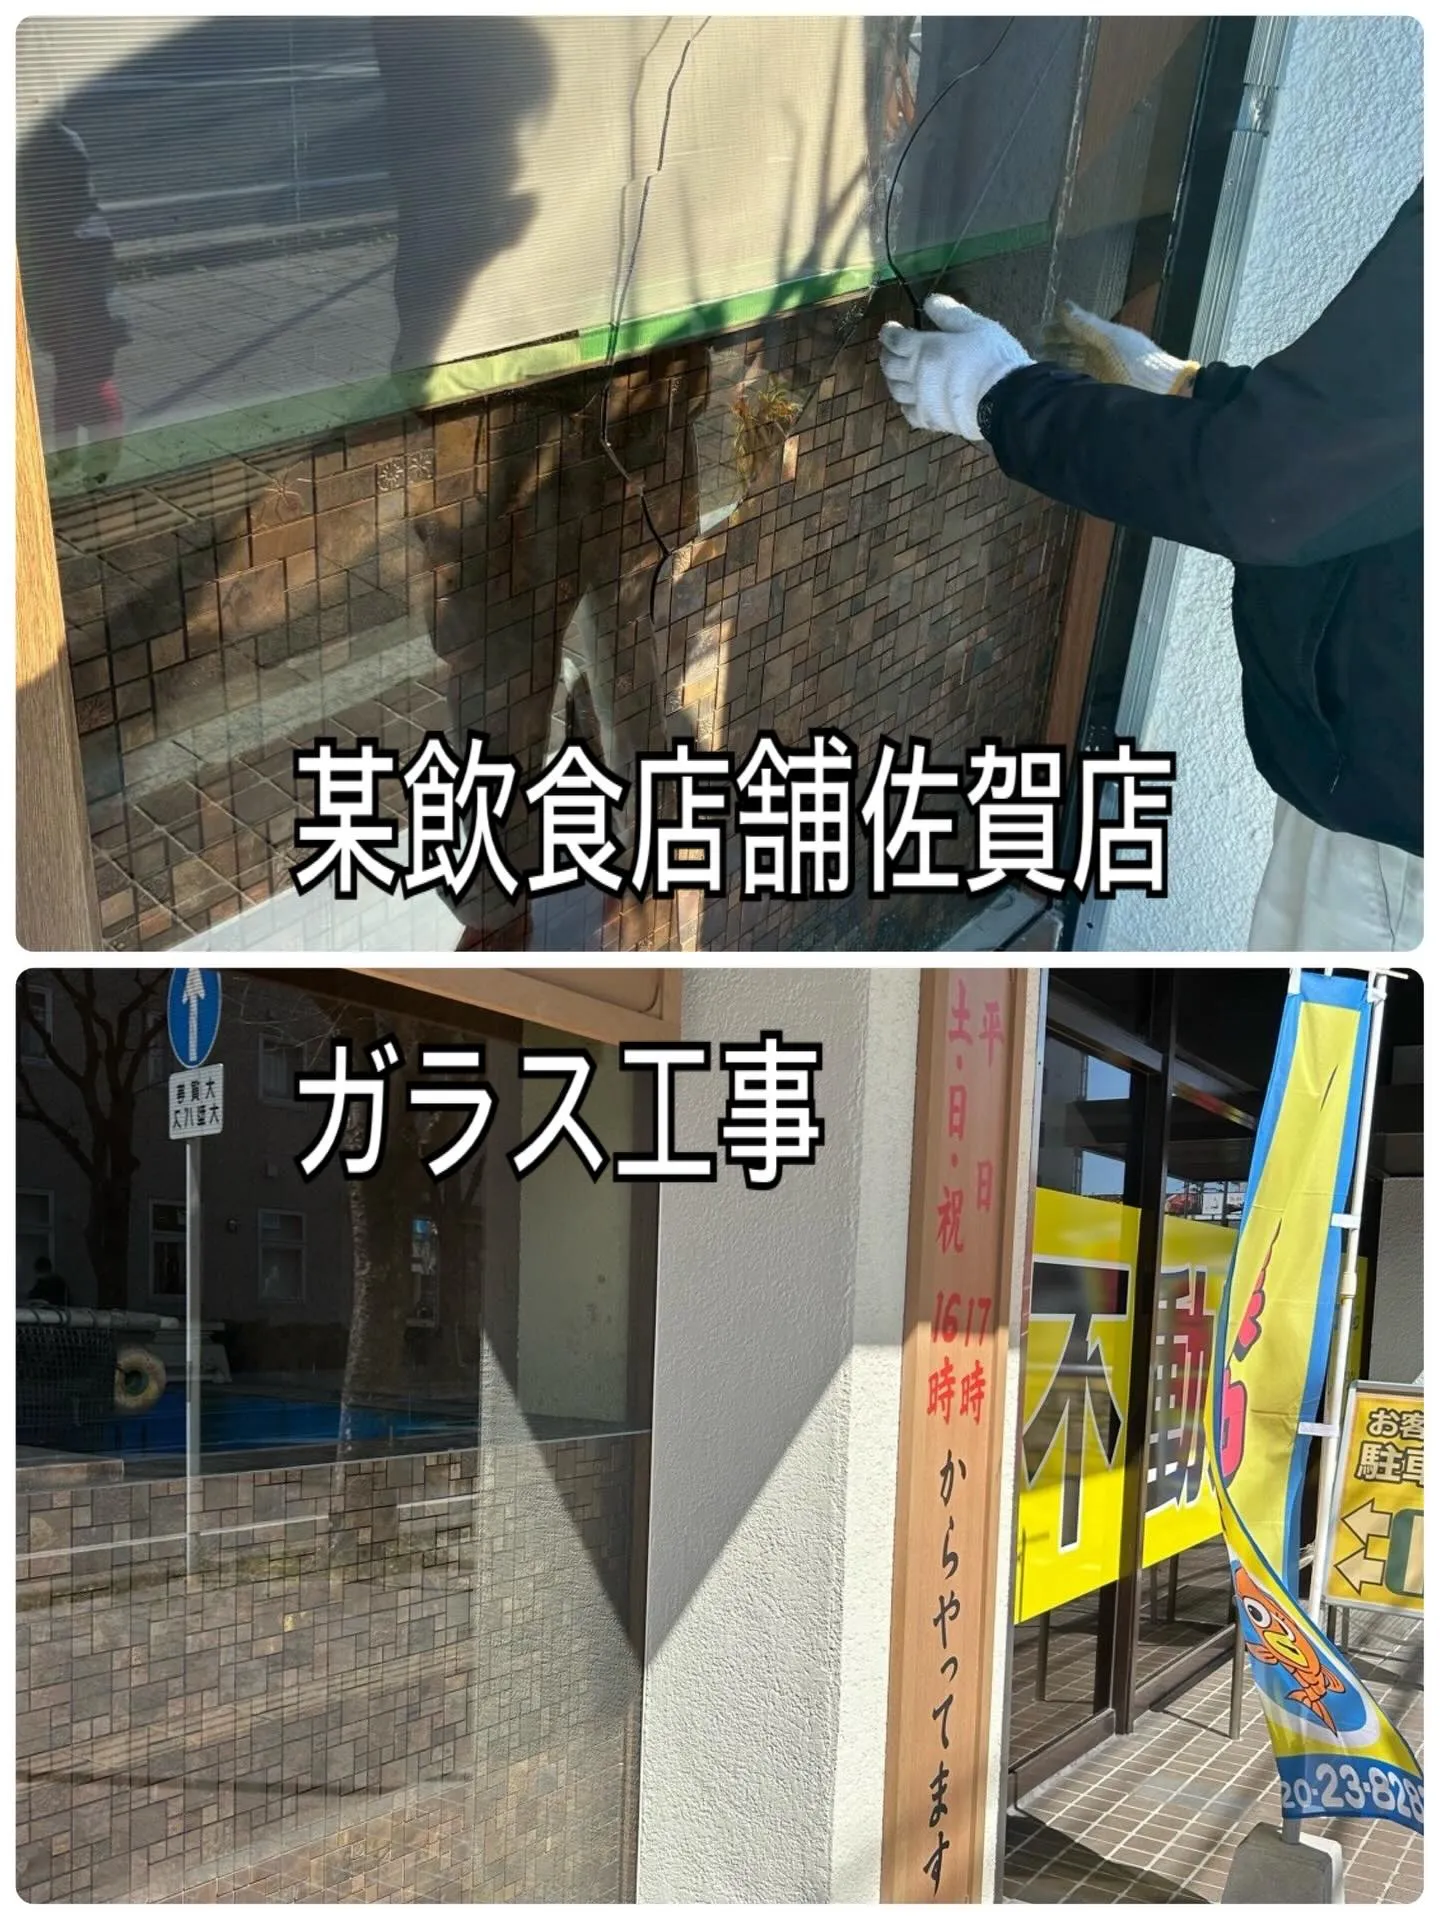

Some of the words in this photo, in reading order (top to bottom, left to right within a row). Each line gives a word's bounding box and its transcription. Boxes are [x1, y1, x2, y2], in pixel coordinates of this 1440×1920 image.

[923, 1449, 966, 1896] からやってます
